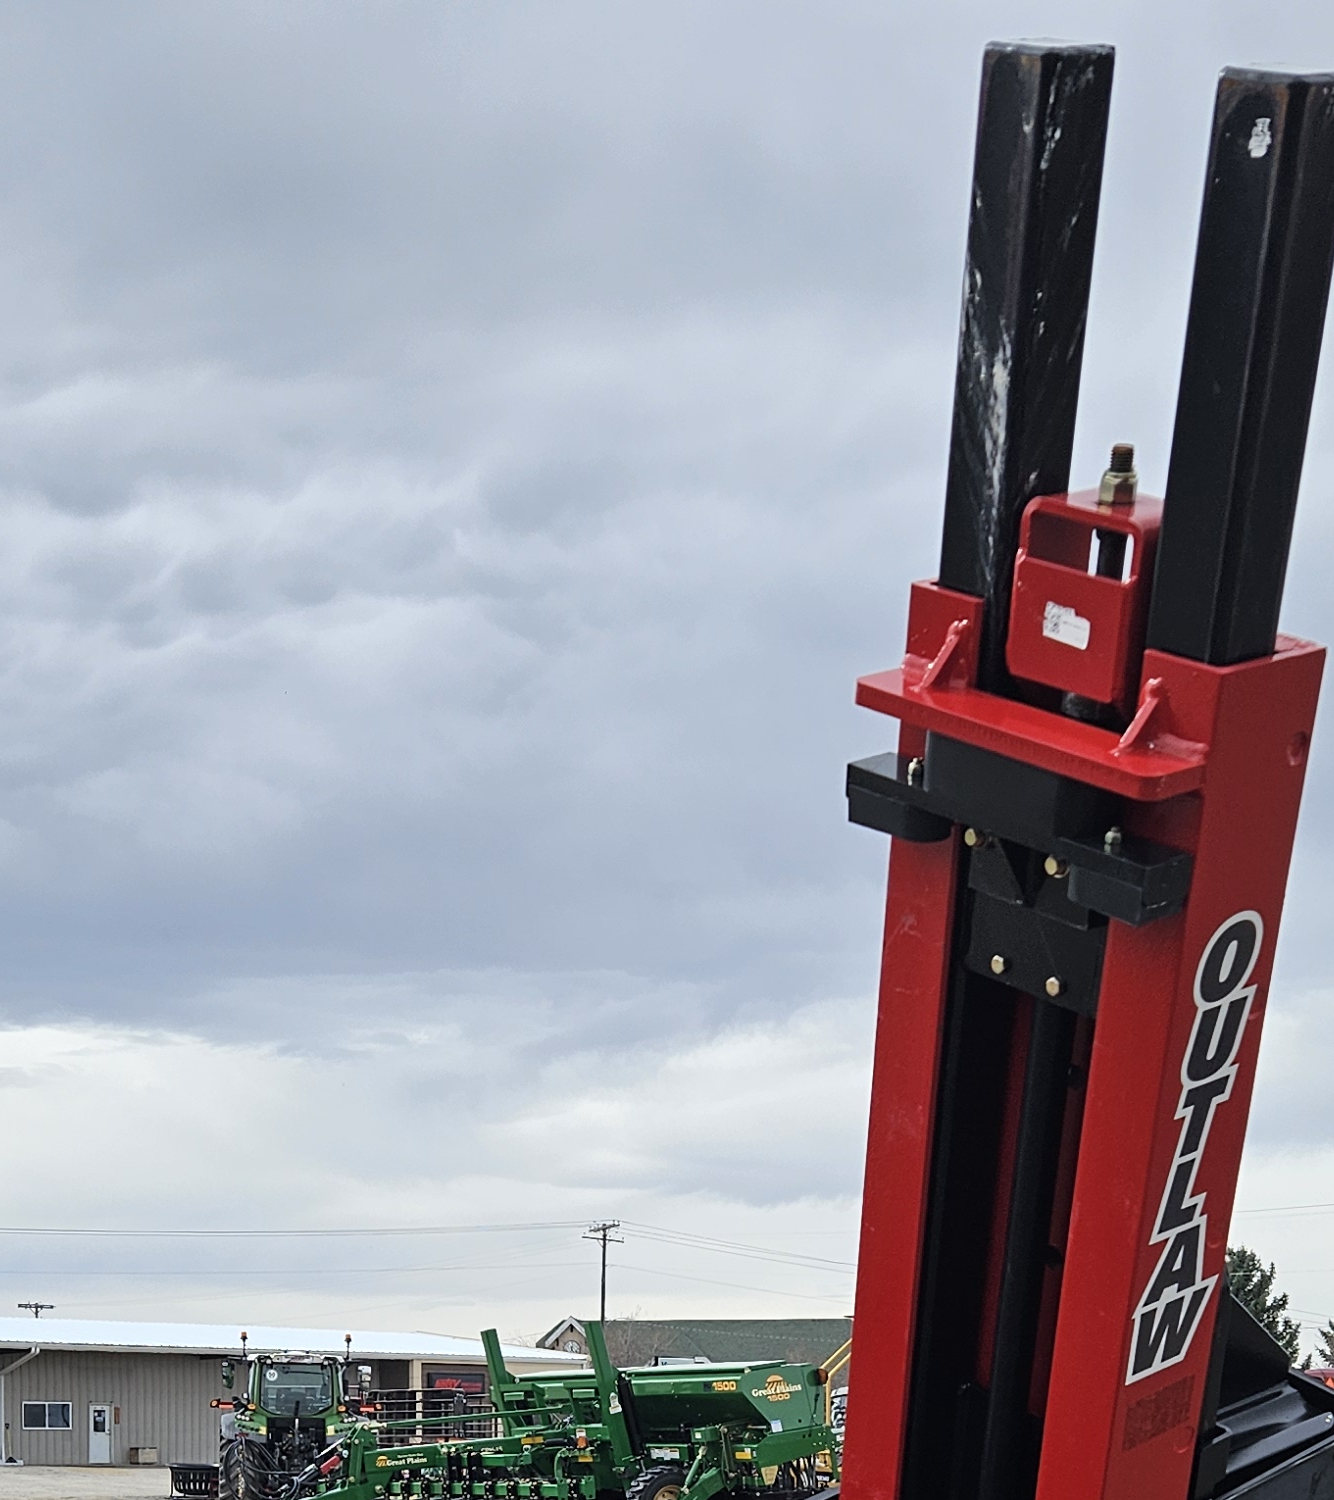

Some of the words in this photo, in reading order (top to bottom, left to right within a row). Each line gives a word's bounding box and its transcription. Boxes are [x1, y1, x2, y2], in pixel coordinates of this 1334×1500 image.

[1126, 910, 1264, 1386] OUTLAW
[711, 1381, 736, 1391] 1500
[751, 1387, 776, 1397] Great
[767, 1393, 790, 1402] 1500
[387, 1458, 406, 1467] Great
[407, 1456, 428, 1465] Plains
